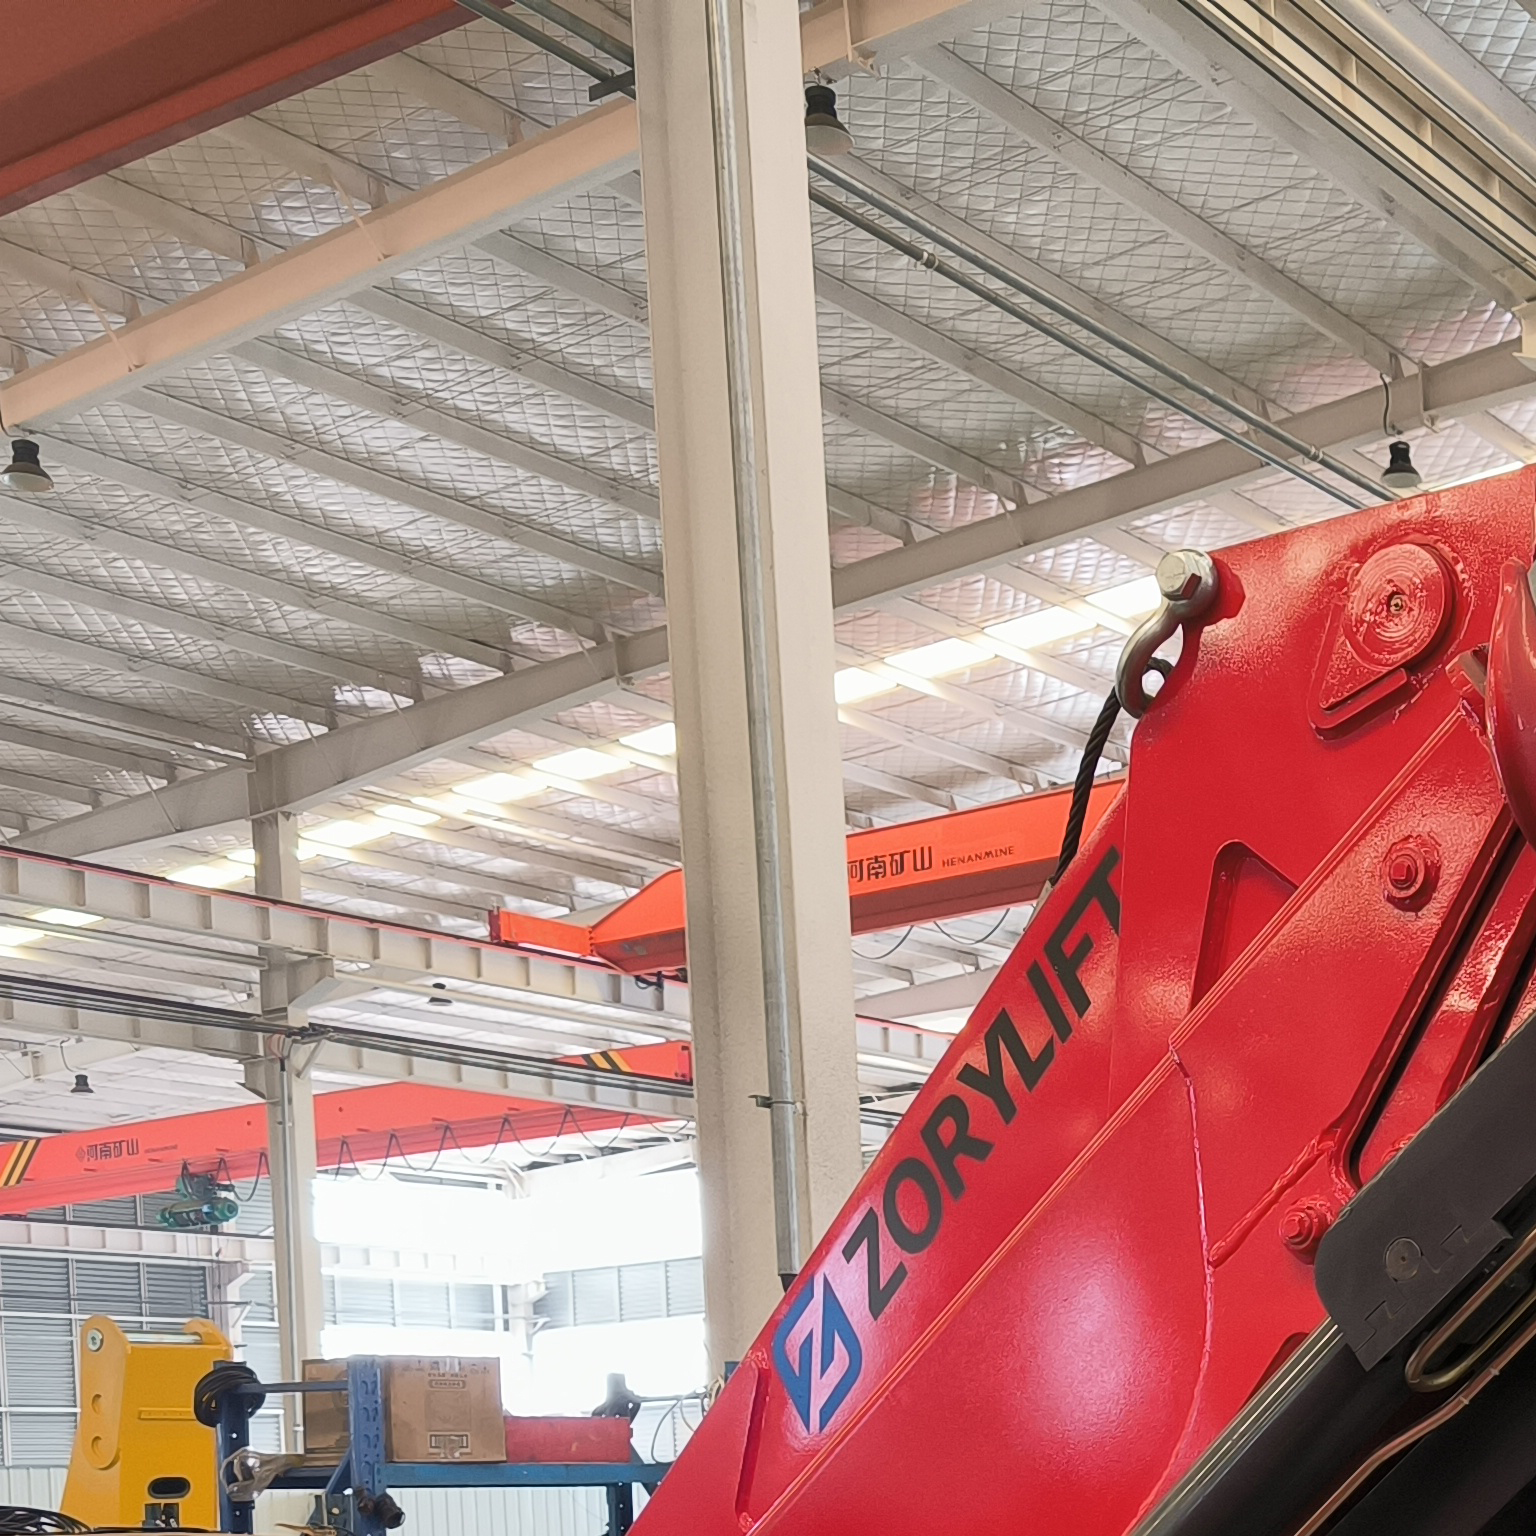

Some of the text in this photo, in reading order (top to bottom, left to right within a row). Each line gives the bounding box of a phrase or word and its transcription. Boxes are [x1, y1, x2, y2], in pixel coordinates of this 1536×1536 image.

[942, 845, 1015, 867] HENANMINE
[841, 846, 1121, 1321] ZORYLIFT
[86, 1138, 140, 1162] 河南矿山
